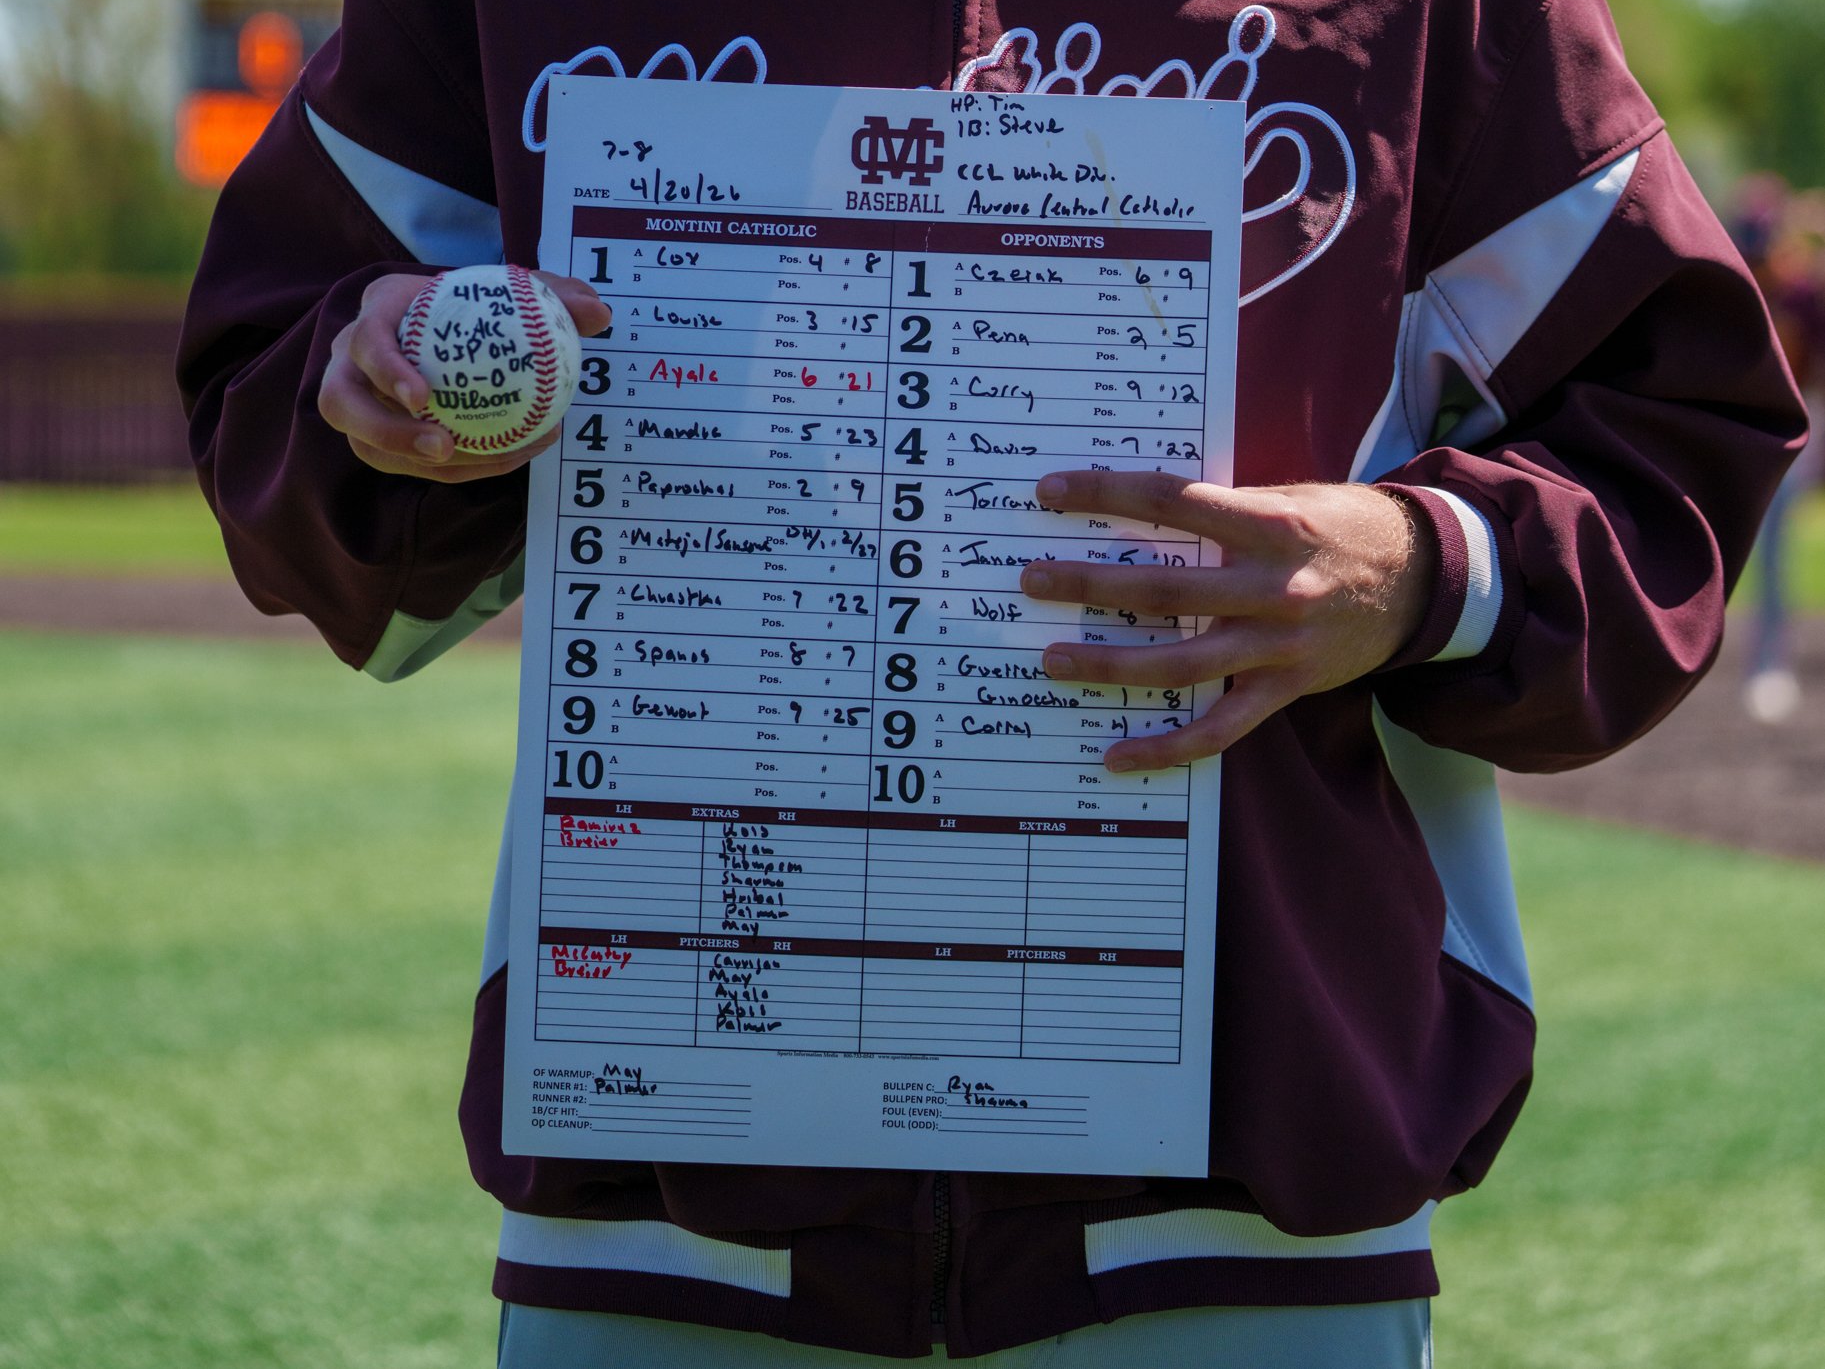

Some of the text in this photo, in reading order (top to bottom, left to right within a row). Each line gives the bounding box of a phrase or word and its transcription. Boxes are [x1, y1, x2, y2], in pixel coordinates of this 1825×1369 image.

[988, 94, 1024, 111] Tim
[999, 114, 1064, 136] Steve
[602, 140, 652, 162] 7-8
[958, 163, 1004, 181] CCL
[574, 168, 740, 205] DATE 4/20/26
[846, 191, 945, 214] BASEBALL
[967, 190, 1030, 215] Aurora
[1120, 194, 1195, 218] Catholic
[645, 218, 817, 237] MONTINI CATHOLIC
[1001, 233, 1105, 249] OPPONENTS
[589, 247, 613, 284] 1
[779, 255, 802, 263] Pos.
[808, 254, 823, 271] 4
[865, 253, 882, 273] 8
[907, 261, 931, 298] 1
[1099, 266, 1193, 290] Pos. 6 9
[489, 302, 515, 316] 26
[776, 314, 799, 323] Pos.
[805, 311, 819, 330] 3
[852, 313, 879, 333] 15
[900, 315, 932, 353] 2
[1097, 326, 1119, 335] Pos.
[1127, 327, 1147, 349] 2
[1173, 324, 1196, 347] 5
[442, 369, 505, 388] 10-0
[578, 357, 611, 395] 3
[774, 369, 796, 378] Pos.
[801, 367, 817, 387] 6
[847, 372, 872, 391] 21
[432, 388, 520, 409] Wilson
[897, 371, 930, 409] 3
[1126, 380, 1142, 399] 9
[1172, 384, 1199, 403] 12
[575, 414, 609, 451] 4
[800, 423, 822, 441] 5
[847, 429, 878, 447] 23
[894, 428, 928, 465] 4
[1121, 437, 1139, 454] 7
[1166, 440, 1200, 460] 22
[574, 468, 605, 508] 5
[768, 480, 791, 489] Pos.
[797, 479, 812, 497] 2
[850, 479, 865, 501] 9
[893, 482, 924, 522] 5
[570, 525, 603, 565] 6
[890, 539, 923, 578] 6
[1118, 549, 1140, 565] 5
[568, 583, 600, 620] 7
[763, 590, 868, 614] Pos. 7 22
[972, 597, 1023, 622] Wolf
[888, 596, 920, 634] 7
[565, 639, 598, 678] 8
[790, 641, 807, 666] 8
[843, 645, 855, 667] 7
[885, 653, 918, 692] 8
[1082, 688, 1104, 697] Pos.
[1163, 689, 1181, 709] 8
[563, 696, 595, 735] 9
[758, 705, 780, 714] Pos.
[833, 707, 871, 726] 25
[883, 710, 916, 749] 9
[552, 750, 604, 790] 10
[1079, 775, 1101, 783] Pos.
[873, 764, 925, 804] 10
[616, 804, 796, 821] LH EXTRAS RH
[940, 818, 1119, 833] LH EXTRAS RH
[611, 934, 791, 951] LH PITCHERS RH
[935, 947, 1117, 962] LH PITCHERS RH
[709, 968, 752, 989] May
[533, 1063, 642, 1081] OF WARMUP: May
[533, 1081, 571, 1091] RUNNER
[573, 1082, 588, 1091] #1:
[883, 1082, 923, 1091] BULLPEN
[926, 1083, 934, 1091] C:
[532, 1094, 587, 1104] RUNNER #2:
[883, 1095, 924, 1104] BULLPEN
[926, 1096, 948, 1105] PRO:
[532, 1106, 579, 1116] 1B/CF HIT:
[882, 1107, 942, 1118] FOUL (EVEN):
[547, 1119, 592, 1129] CLEANUP:
[882, 1120, 939, 1130] FOUL (ODD):
